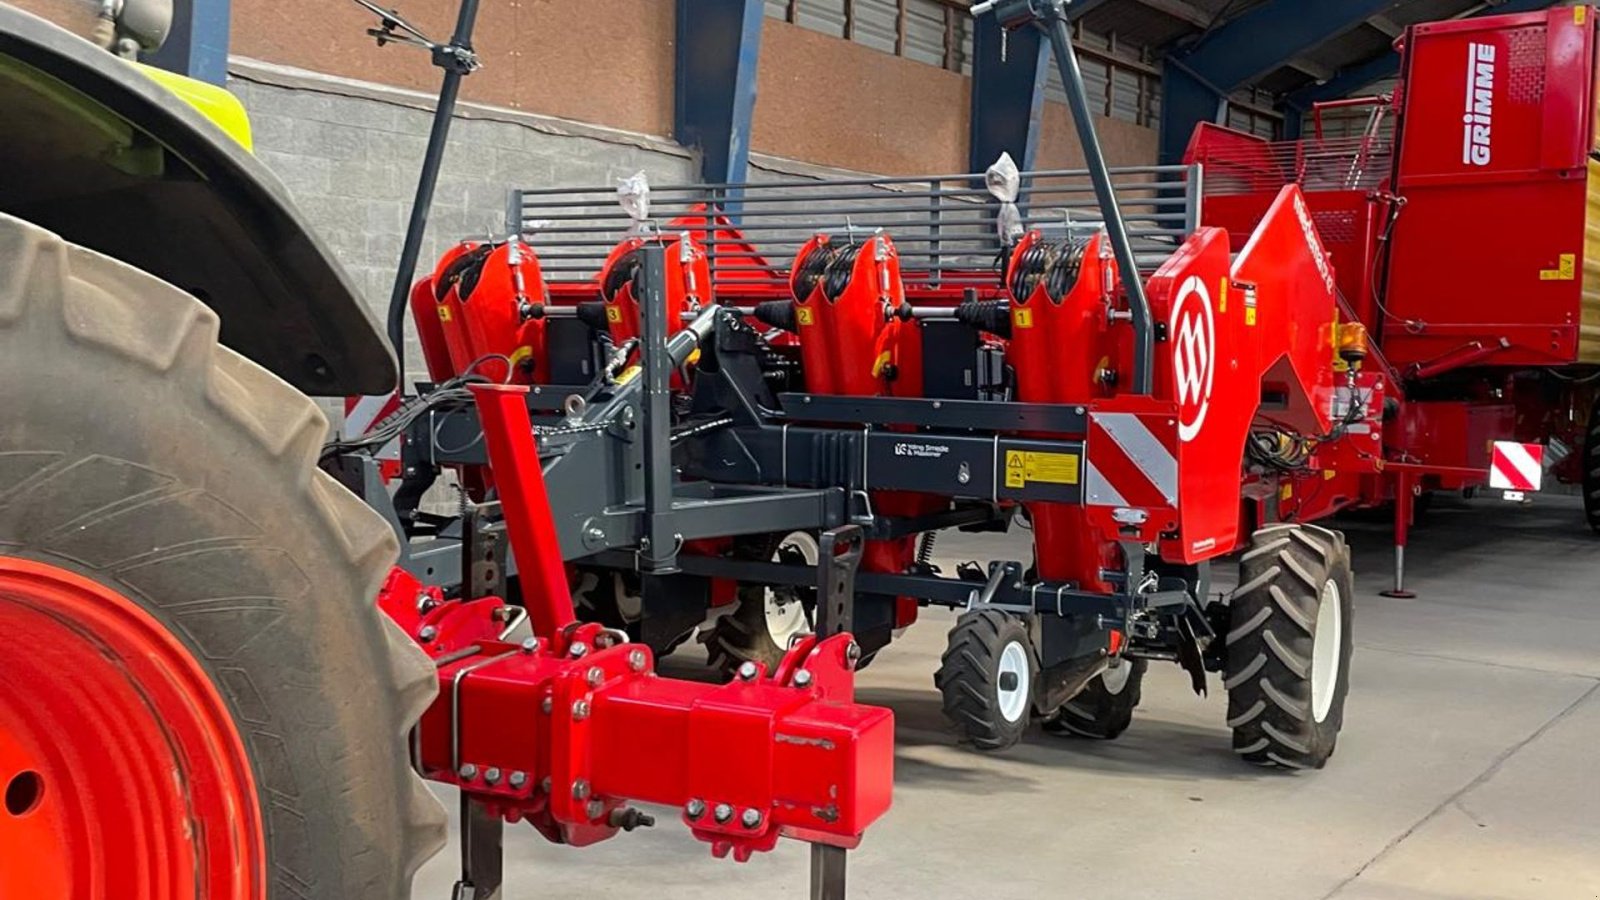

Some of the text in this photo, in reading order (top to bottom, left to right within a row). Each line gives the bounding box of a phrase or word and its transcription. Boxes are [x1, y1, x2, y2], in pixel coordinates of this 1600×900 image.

[1463, 43, 1495, 166] GRIMME
[609, 309, 617, 320] 3
[799, 310, 808, 322] 2
[1018, 313, 1025, 324] 1
